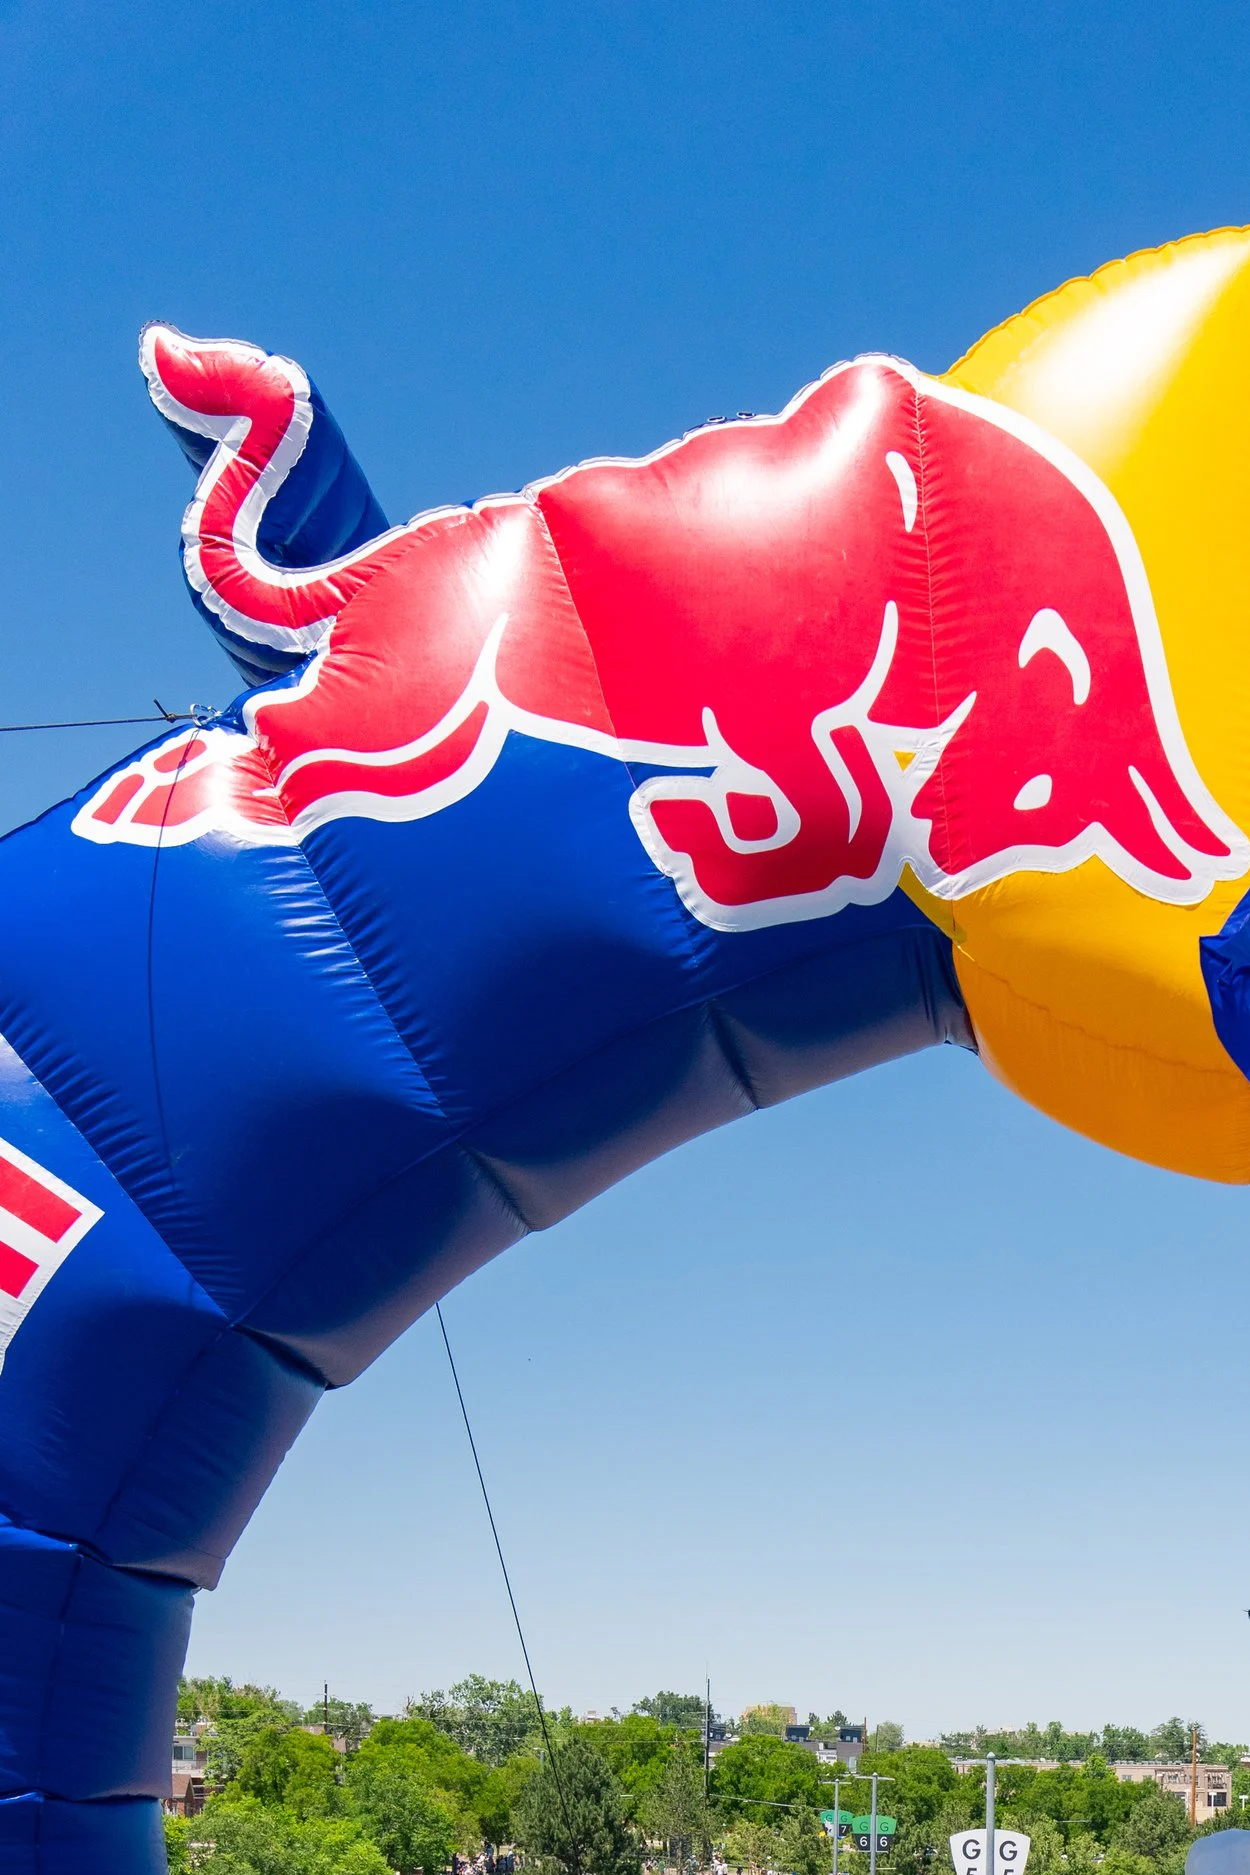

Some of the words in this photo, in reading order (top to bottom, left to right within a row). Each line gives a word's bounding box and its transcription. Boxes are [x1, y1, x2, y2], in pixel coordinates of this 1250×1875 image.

[841, 1825, 847, 1833] 7
[860, 1821, 869, 1832] G
[880, 1822, 889, 1832] G
[860, 1836, 868, 1847] 6
[879, 1836, 888, 1847] 6
[962, 1839, 981, 1860] G
[999, 1840, 1018, 1861] G
